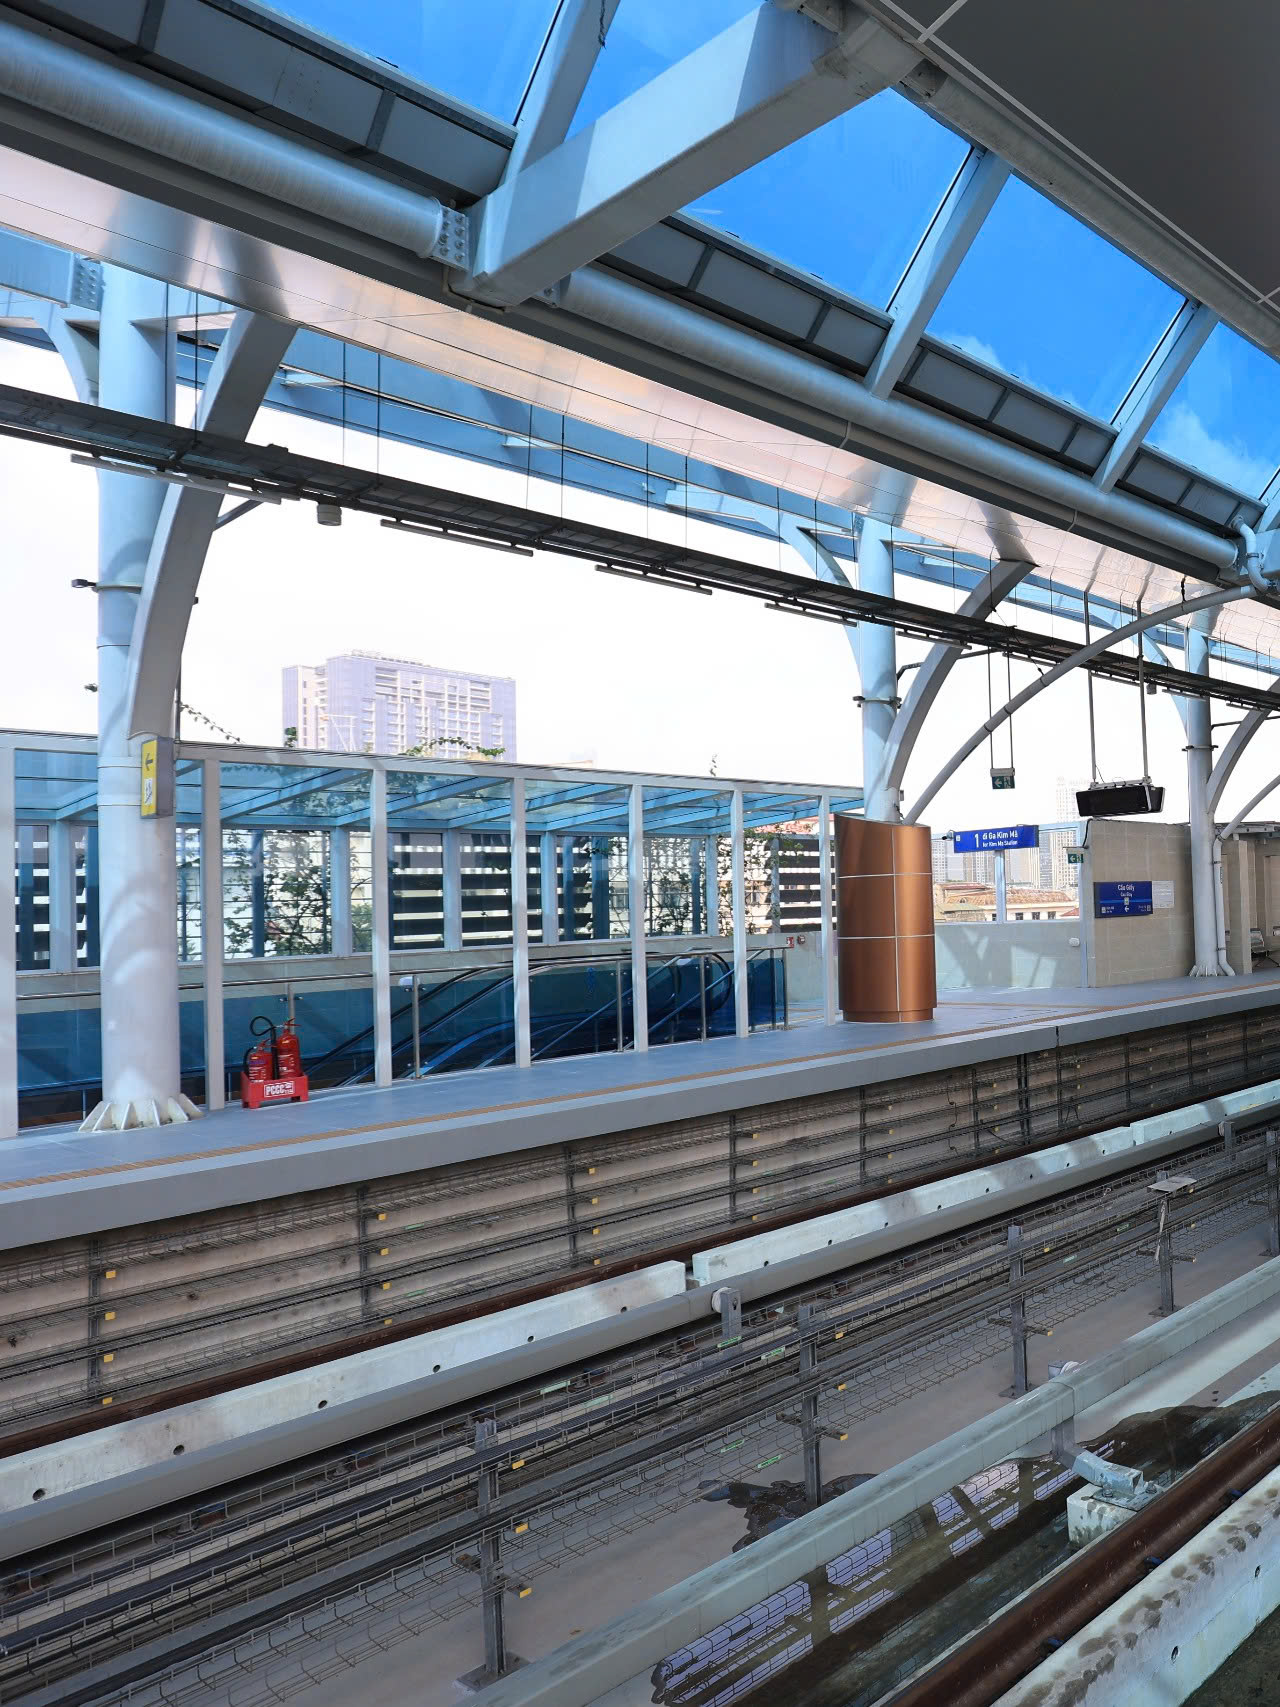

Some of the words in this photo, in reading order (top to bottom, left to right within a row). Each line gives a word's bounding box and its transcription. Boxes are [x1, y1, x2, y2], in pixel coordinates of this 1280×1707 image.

[974, 833, 980, 848] 1
[988, 831, 996, 840] Ga
[996, 830, 1009, 839] Kim
[265, 1084, 285, 1096] PCCC
